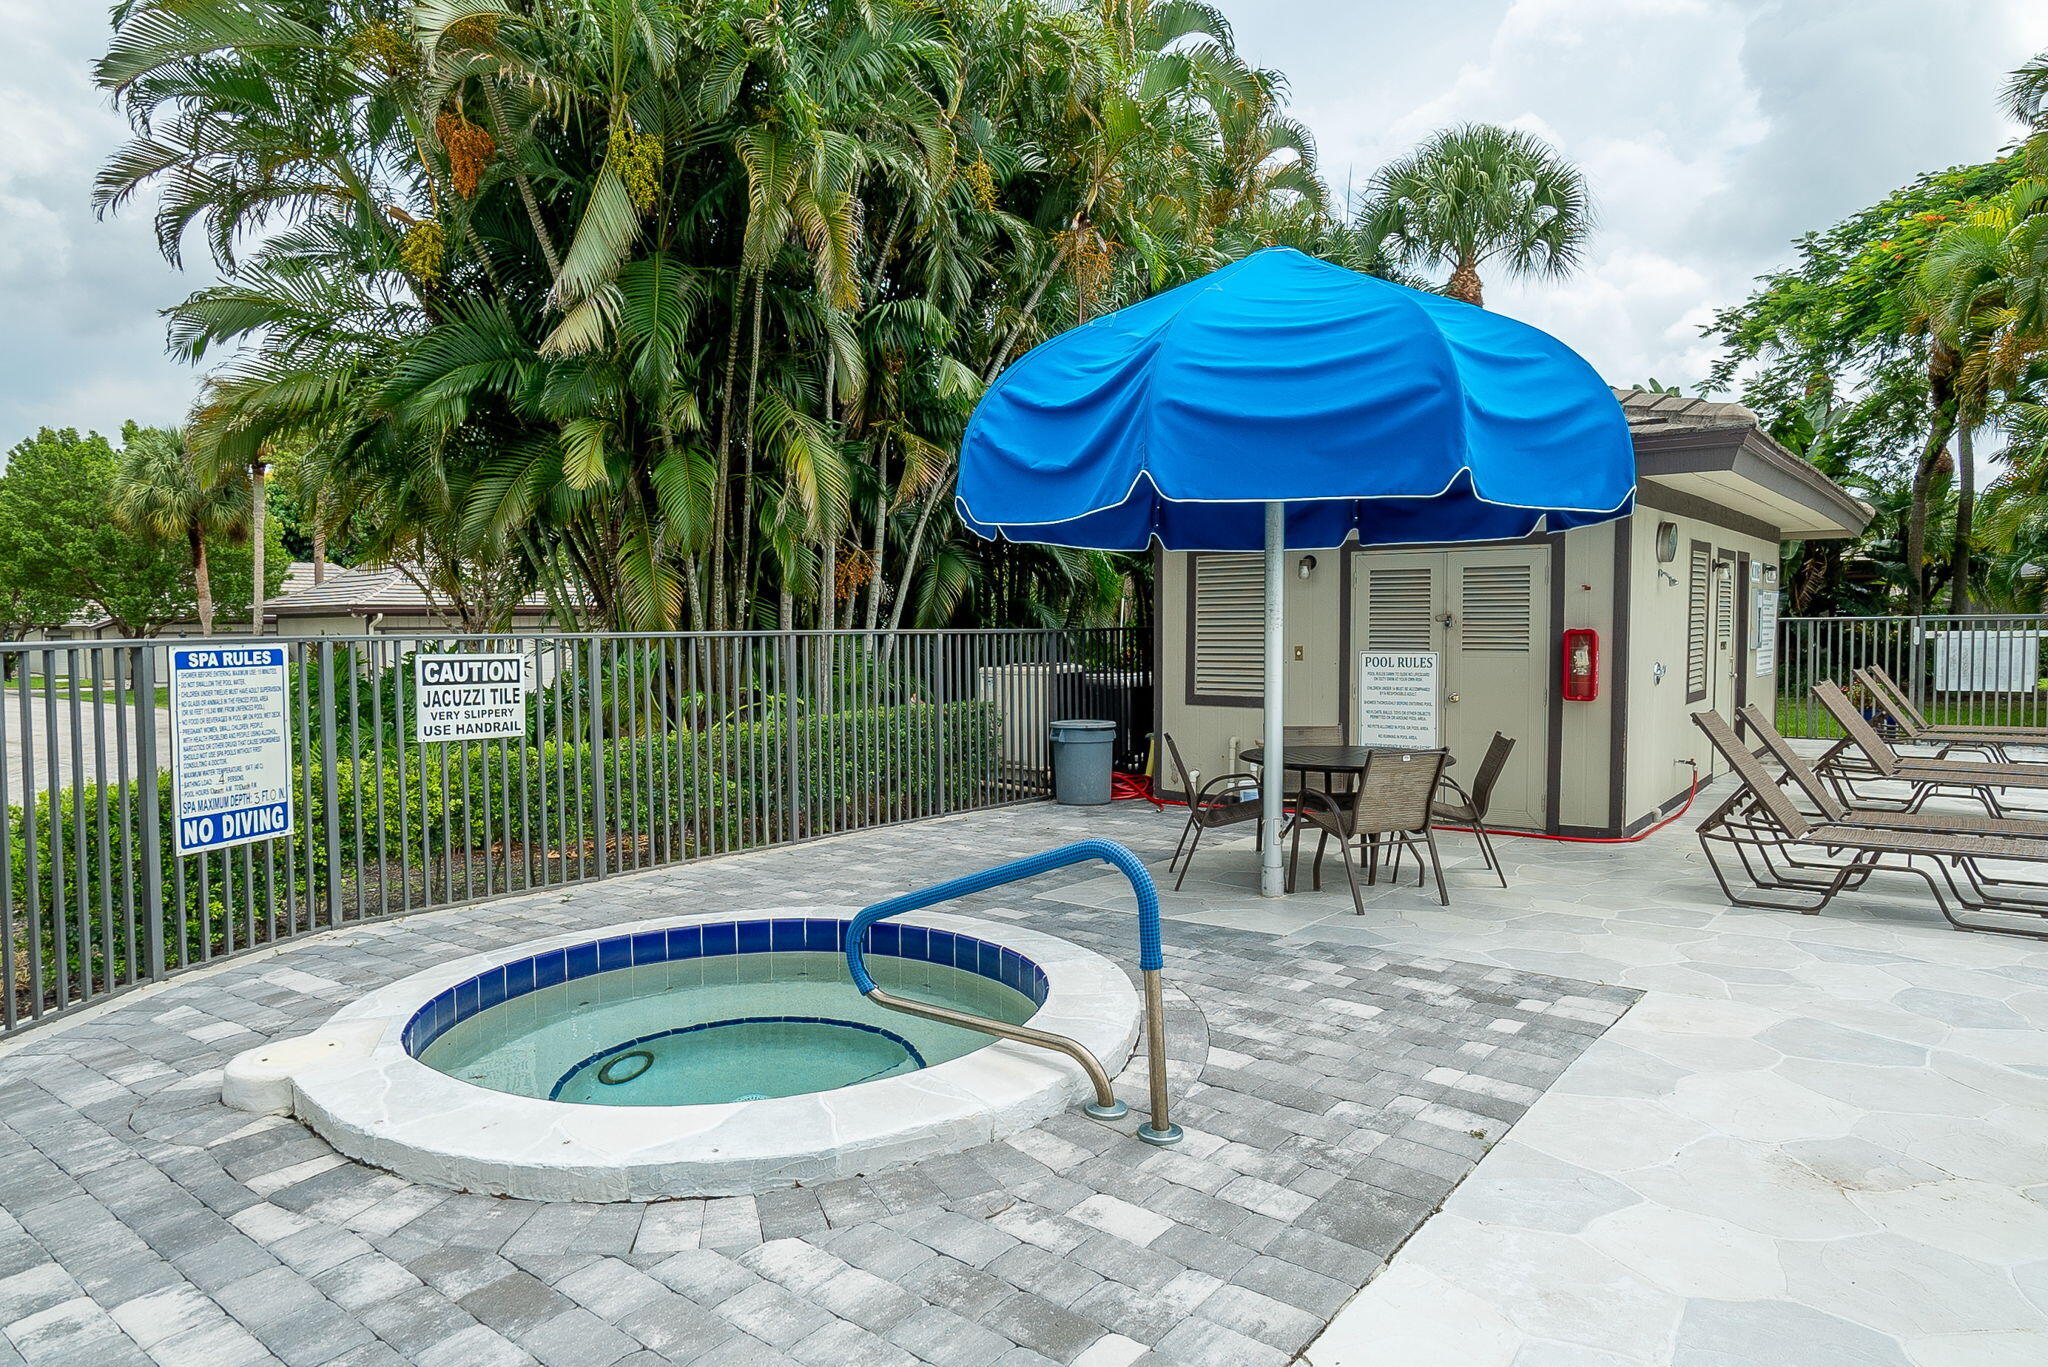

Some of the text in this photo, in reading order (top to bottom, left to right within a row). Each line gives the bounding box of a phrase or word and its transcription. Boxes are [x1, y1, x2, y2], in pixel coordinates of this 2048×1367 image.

[188, 651, 272, 667] SPA RULES
[1365, 656, 1433, 669] POOL RULES
[424, 661, 518, 683] CAUTION
[423, 687, 520, 708] JACUZZI TILE
[430, 708, 515, 721] VERY SLIPPERY
[423, 721, 522, 737] USE HANDRAIL
[219, 774, 225, 784] 4
[183, 802, 196, 814] SPA
[198, 796, 229, 812] MAXIMUM
[230, 793, 252, 807] DEPTH:
[254, 792, 260, 804] 3
[183, 805, 284, 846] NO DIVING
